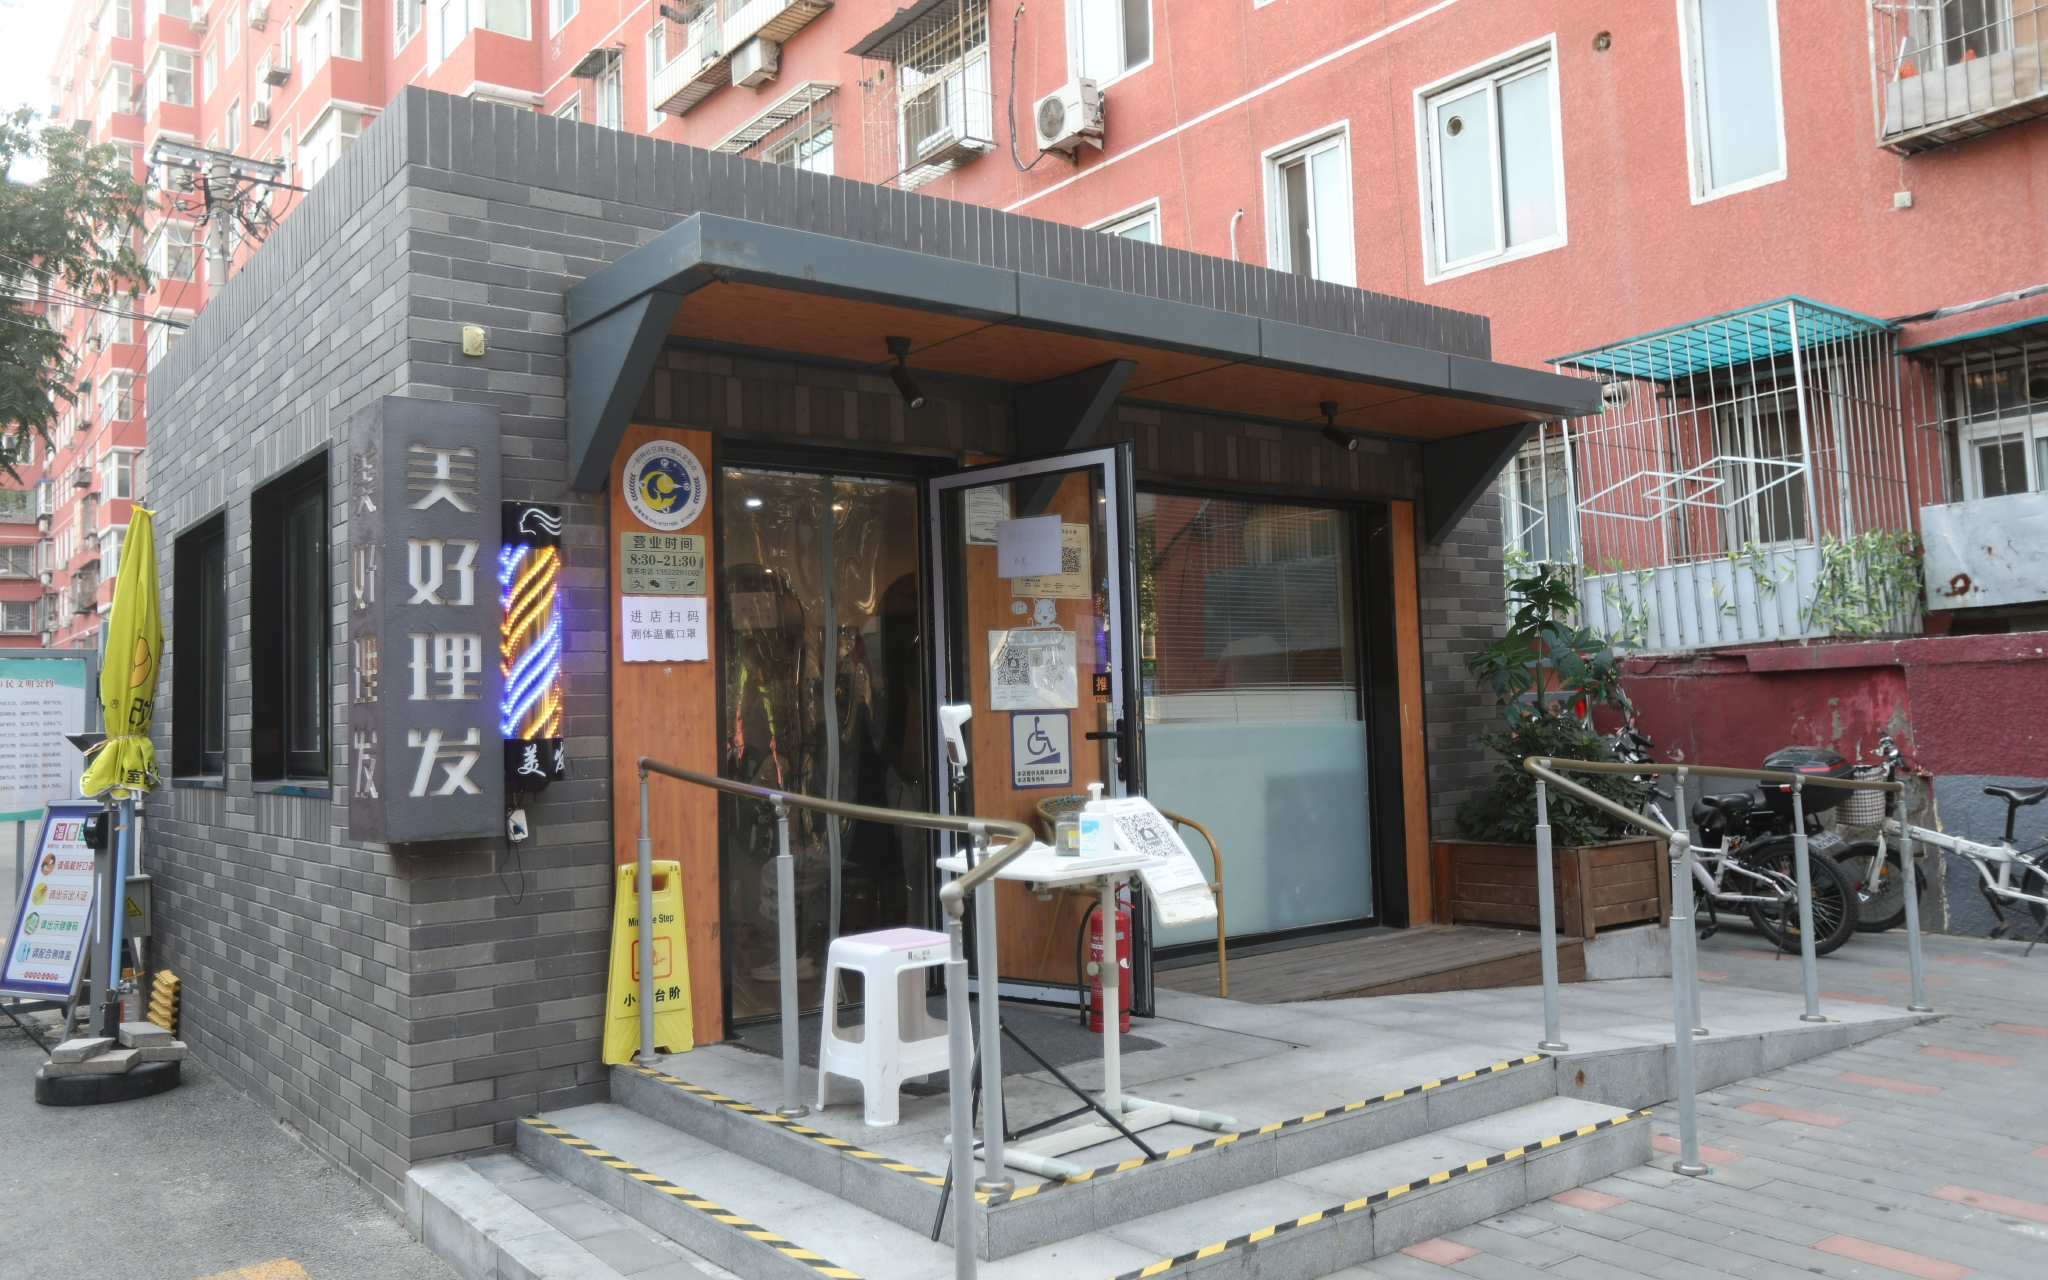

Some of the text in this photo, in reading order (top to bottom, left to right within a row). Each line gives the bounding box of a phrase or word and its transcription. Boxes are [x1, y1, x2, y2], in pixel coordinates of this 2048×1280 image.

[633, 535, 693, 550] 营业时间
[630, 553, 696, 567] 8:30-21:30
[406, 443, 483, 797] 美好理发
[630, 629, 697, 640] 测体温戴口罩
[1096, 676, 1108, 691] 推
[48, 889, 88, 901] 请出示出入证
[659, 914, 674, 924] Step
[623, 985, 681, 1007] 小台阶
